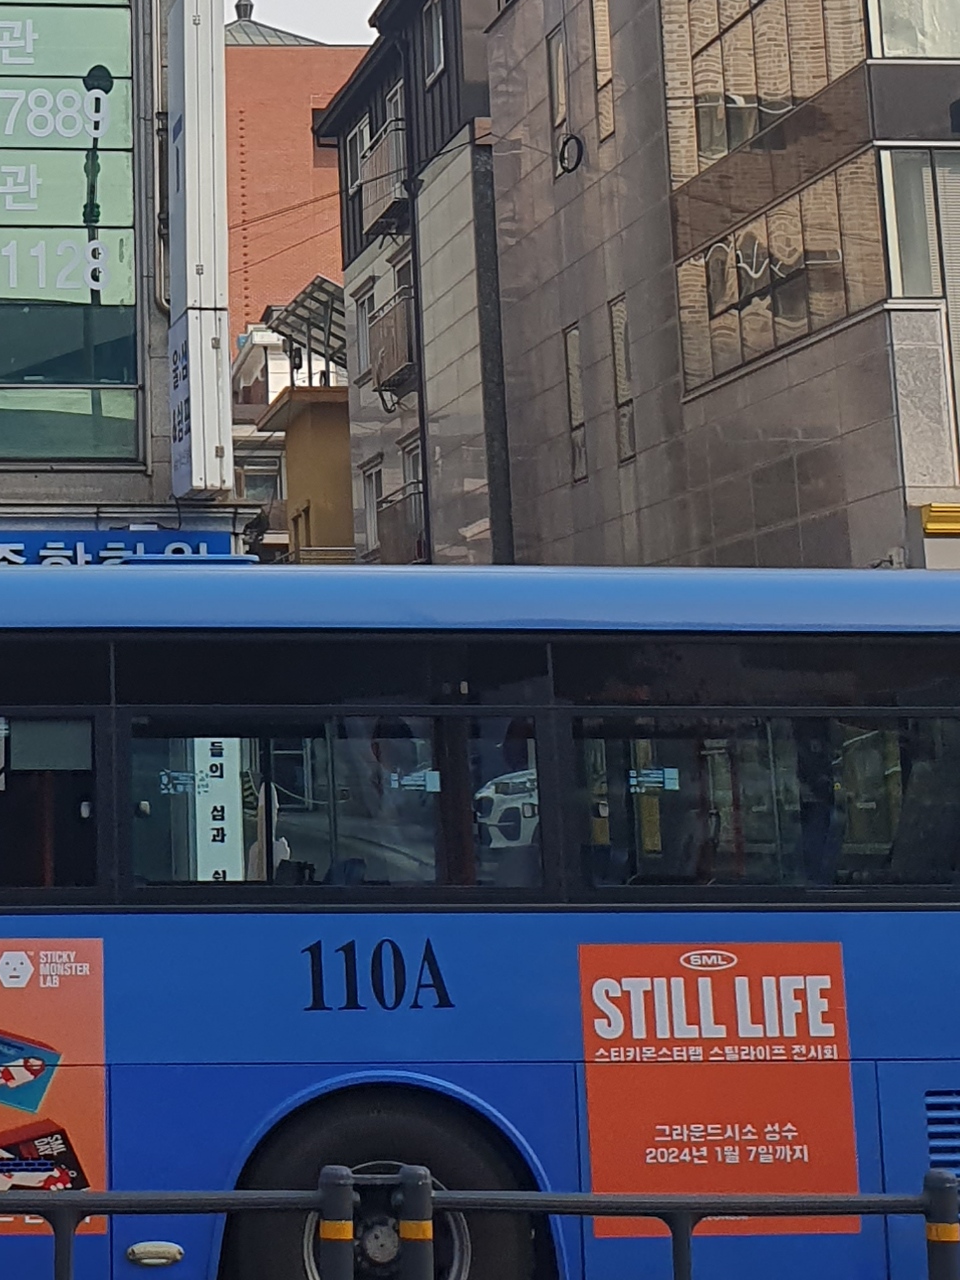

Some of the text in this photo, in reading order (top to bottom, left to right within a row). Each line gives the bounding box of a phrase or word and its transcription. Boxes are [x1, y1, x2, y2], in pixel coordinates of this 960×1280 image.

[210, 805, 227, 843] 섬과
[39, 950, 76, 963] STICKY
[689, 954, 728, 966] SML
[39, 963, 90, 975] MONSTER
[301, 937, 456, 1012] 110A
[39, 975, 60, 988] LAB
[592, 975, 836, 1040] STILL LIFE
[594, 1044, 839, 1062] 스티키몬스터랩 스틸라이프 전시회
[654, 1122, 799, 1142] 그라운드시소 성수
[645, 1144, 809, 1164] 2024년 1월 7일까지
